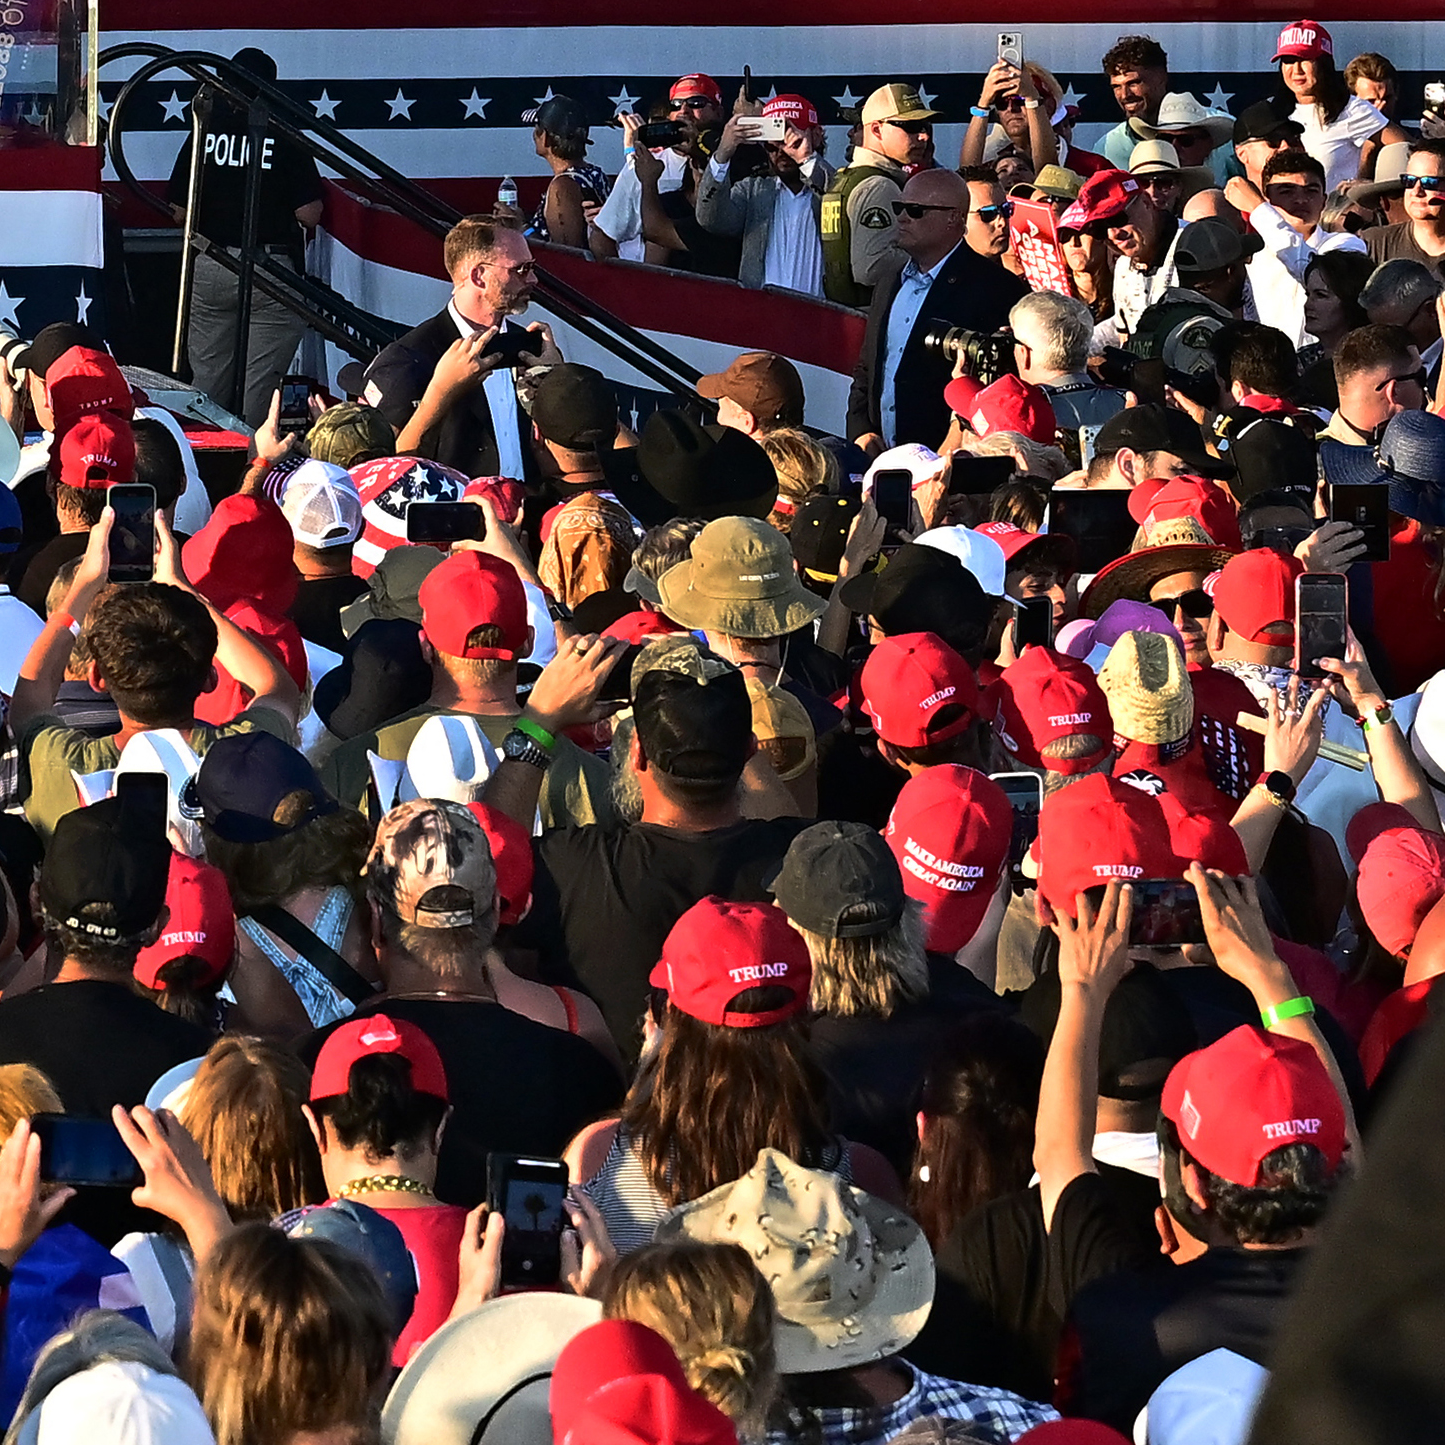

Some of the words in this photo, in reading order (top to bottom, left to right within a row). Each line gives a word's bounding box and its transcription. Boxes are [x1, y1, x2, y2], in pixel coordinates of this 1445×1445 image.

[1280, 28, 1315, 48] TRUMP
[204, 134, 274, 169] POLIE
[80, 454, 116, 468] TRUMP
[919, 687, 955, 709] TRUMP
[1048, 713, 1091, 726] TRUMP
[936, 855, 984, 878] AMERICA
[1093, 865, 1143, 878] TRUMP
[939, 877, 975, 891] AGAIN
[161, 931, 205, 946] TRUMP
[729, 963, 787, 982] TRUMP
[1262, 1119, 1320, 1139] TRUMP
